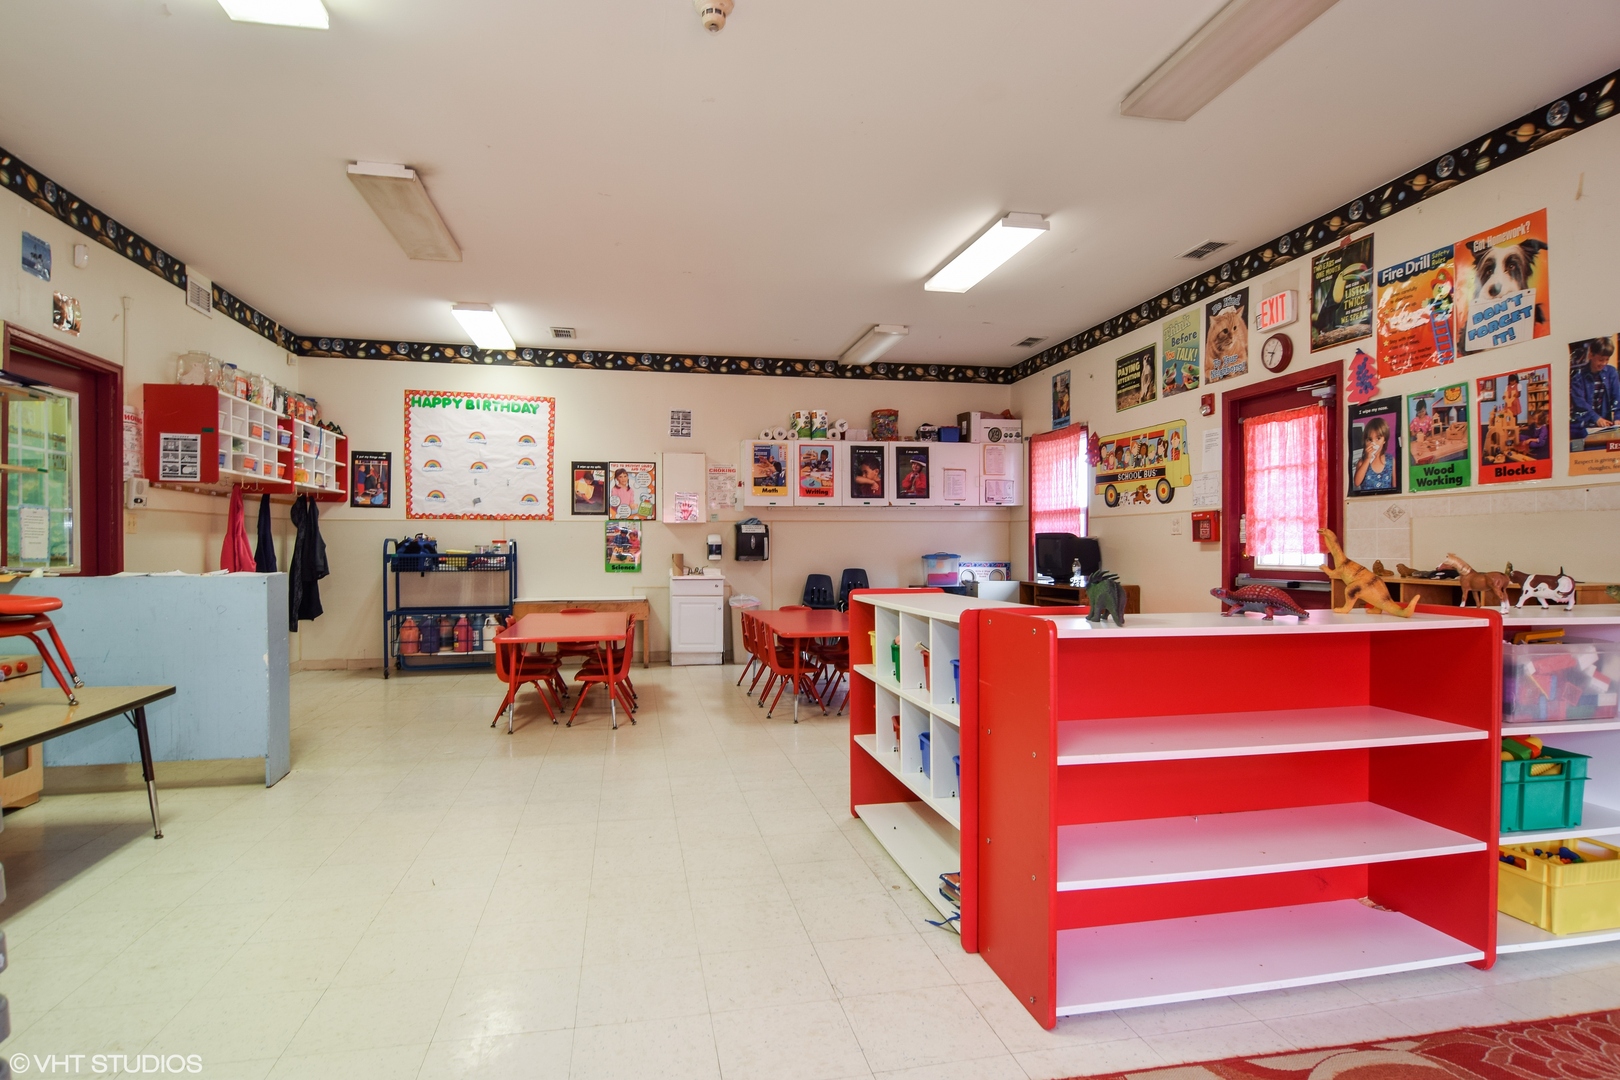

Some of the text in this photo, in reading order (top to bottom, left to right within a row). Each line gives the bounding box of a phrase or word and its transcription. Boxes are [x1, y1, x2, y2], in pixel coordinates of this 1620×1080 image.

[1473, 220, 1531, 253] Got Homework?
[1431, 249, 1450, 260] Safety
[1431, 257, 1446, 266] Rules
[1381, 253, 1431, 284] Fire Drill
[1345, 282, 1370, 299] LISTEN
[1261, 292, 1286, 328] EXIT
[1344, 294, 1365, 310] TWICE
[1472, 293, 1523, 325] DON'T
[1163, 314, 1191, 341] Think
[1341, 315, 1349, 324] WE
[1467, 305, 1533, 341] FORGET
[1171, 331, 1198, 347] Before
[1492, 326, 1516, 347] IT!
[1165, 347, 1198, 362] You TALK!
[1223, 353, 1239, 365] Your
[1117, 361, 1140, 378] PAYING
[411, 396, 540, 414] HAPPY BIRTHDAY
[1117, 469, 1157, 481] SCHOOL BUS
[1423, 463, 1455, 476] Wood
[1494, 464, 1536, 478] Blocks
[1416, 474, 1463, 487] Working
